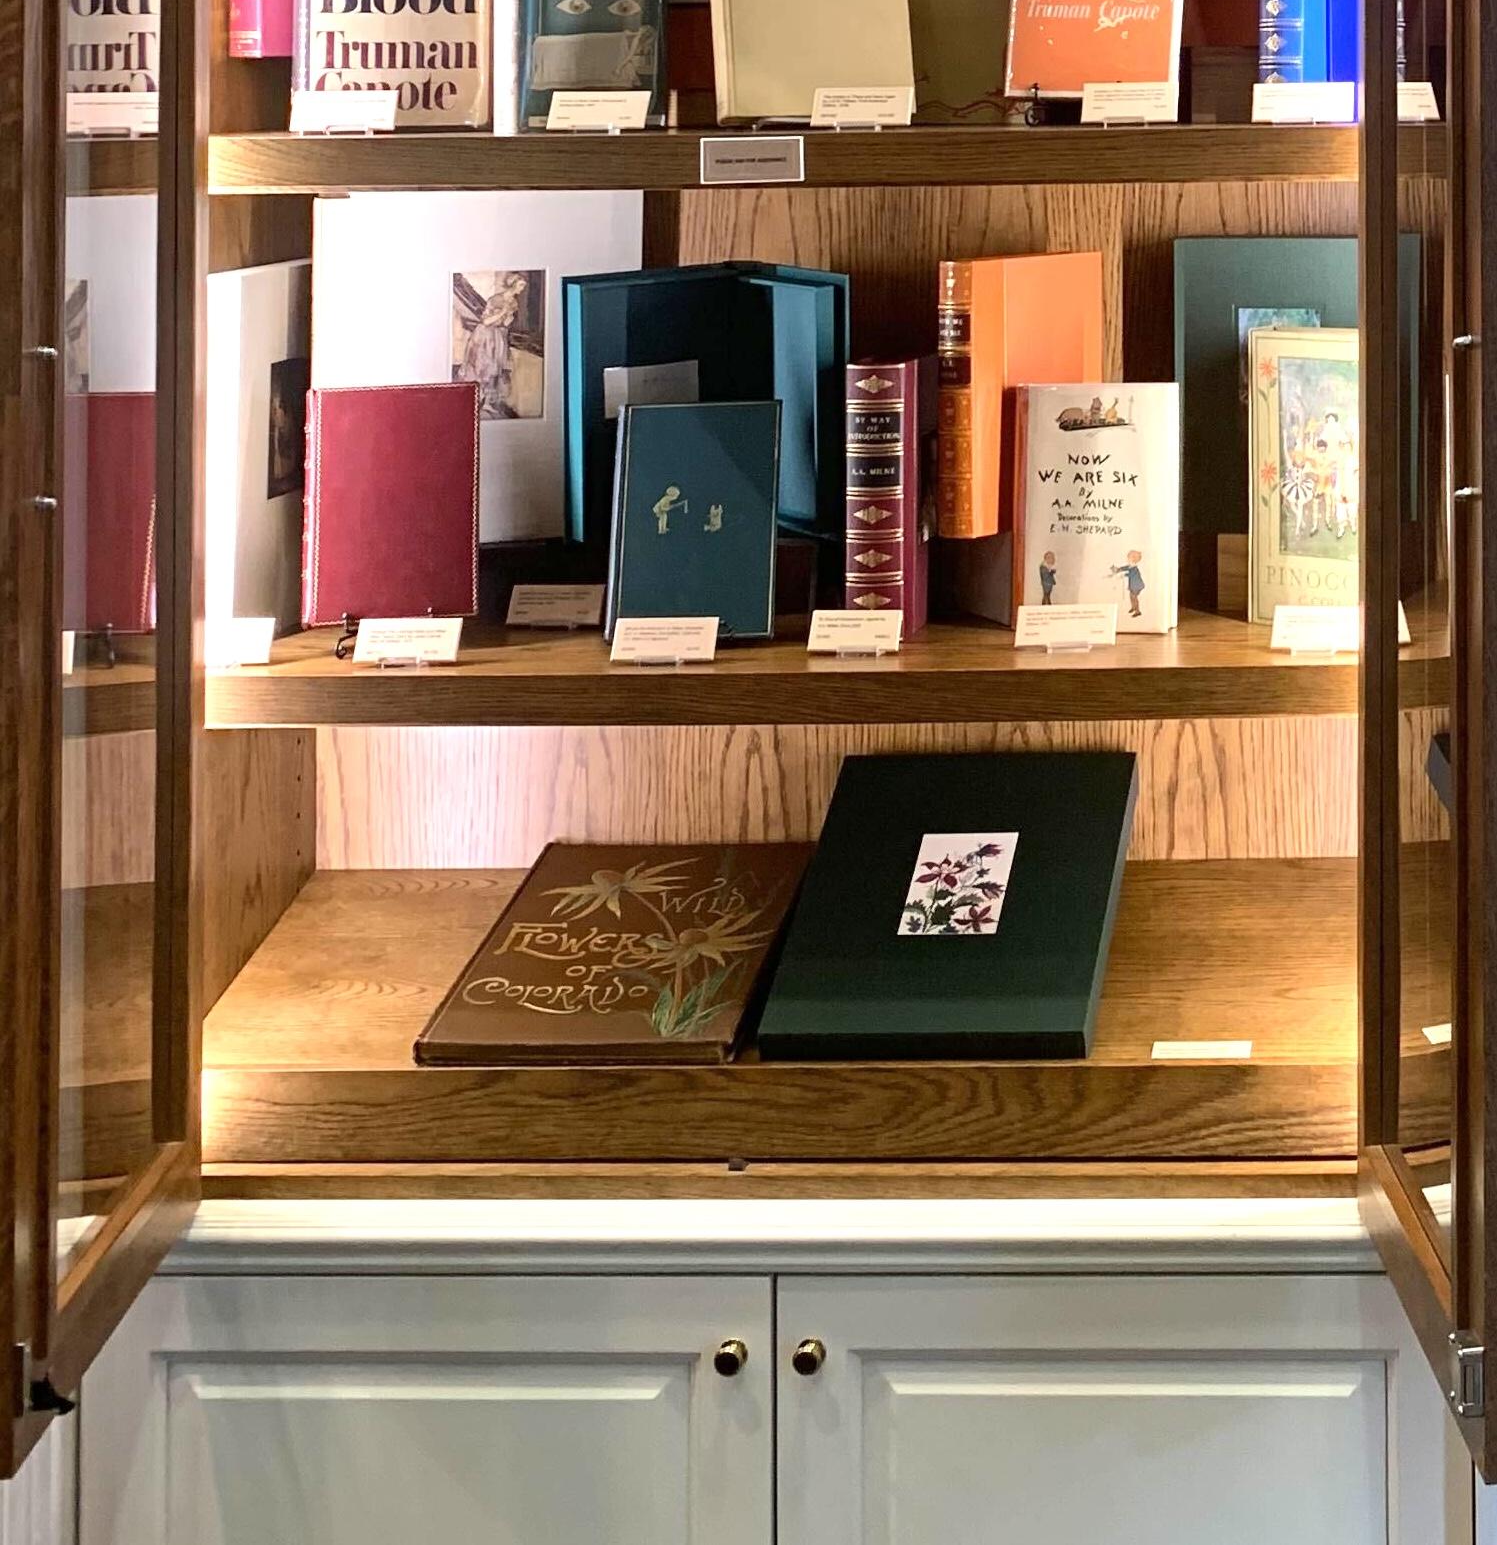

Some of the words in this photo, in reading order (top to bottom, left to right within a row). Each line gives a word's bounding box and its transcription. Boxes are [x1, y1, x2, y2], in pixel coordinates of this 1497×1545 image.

[1098, 0, 1161, 21] Capote
[315, 31, 478, 71] Truman
[870, 416, 891, 424] WAY
[1067, 454, 1110, 465] NOW
[1038, 469, 1062, 484] WE
[1073, 471, 1103, 486] ARE
[1112, 471, 1138, 487] SIX
[1082, 499, 1124, 510] MILNE
[1058, 512, 1100, 522] Decorations
[1075, 524, 1123, 536] SHEPARD
[658, 878, 746, 917] WILD
[493, 922, 666, 968] FLOWERS
[565, 965, 613, 984] OF
[462, 975, 649, 1014] COLORADO
